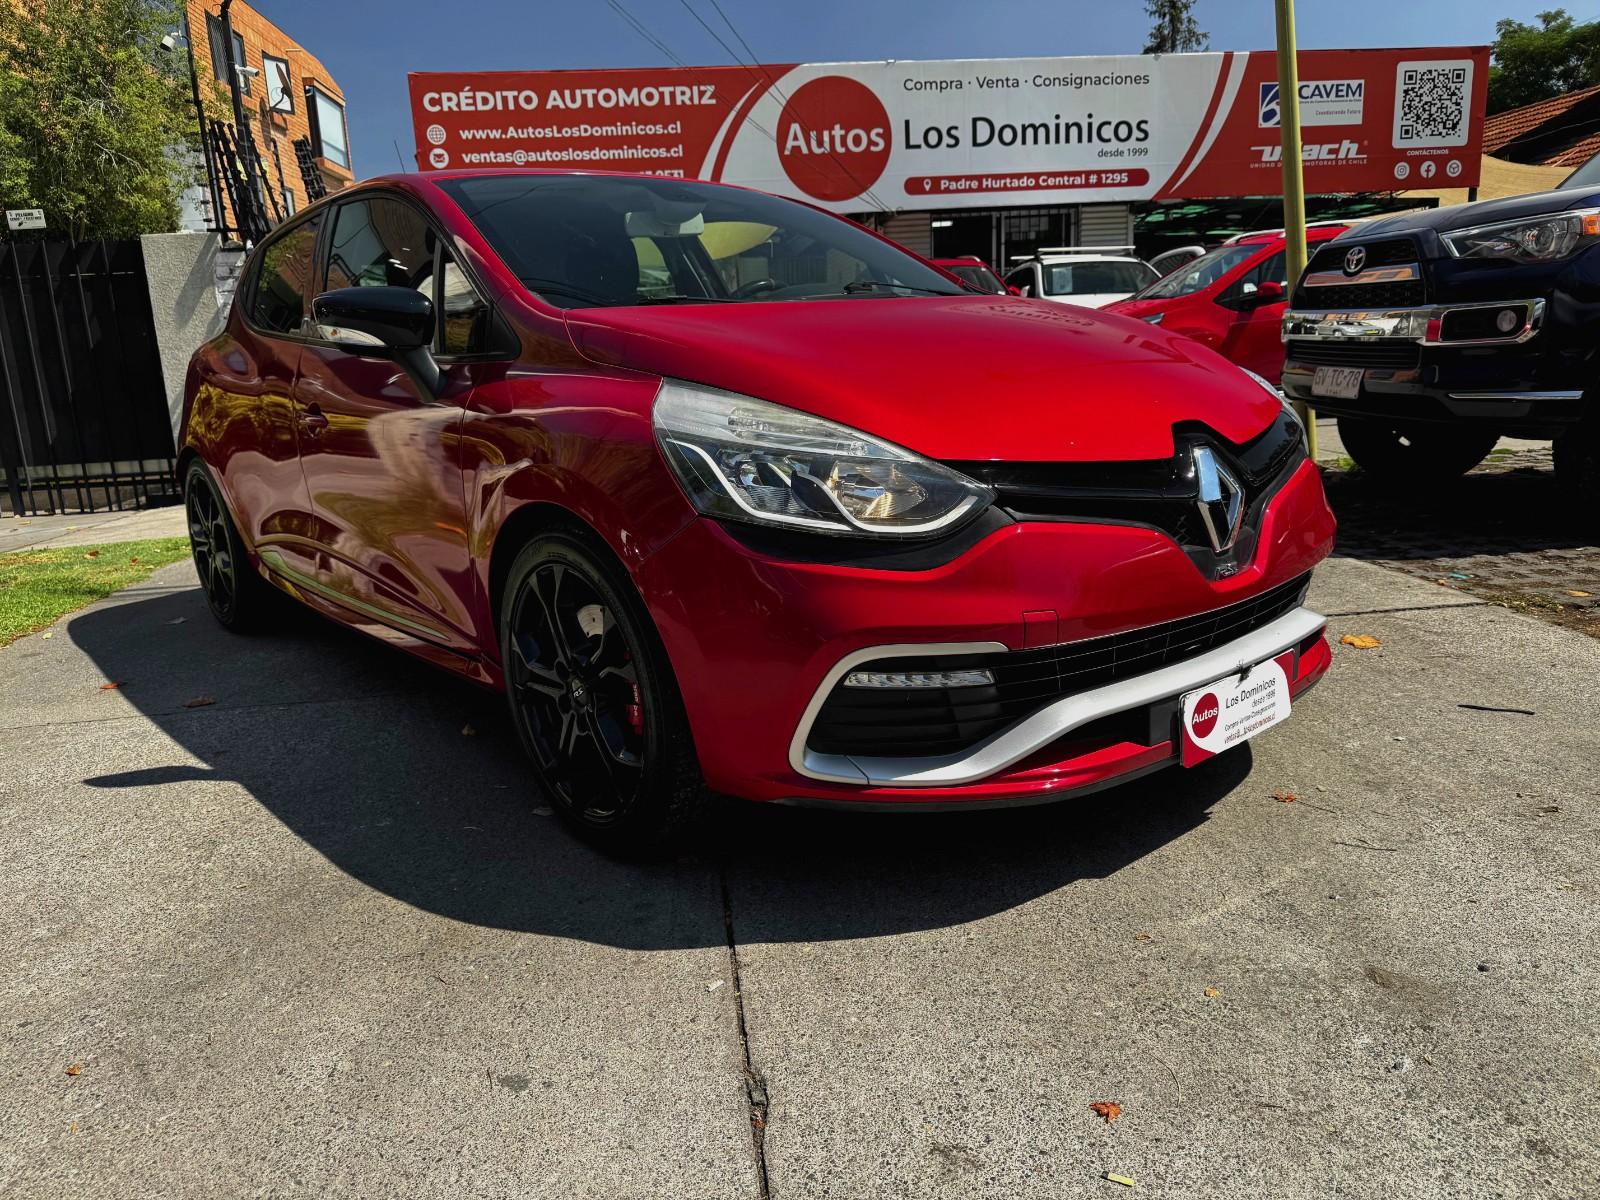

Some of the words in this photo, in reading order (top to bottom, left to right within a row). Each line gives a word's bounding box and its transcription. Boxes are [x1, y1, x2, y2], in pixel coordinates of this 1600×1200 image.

[903, 77, 963, 94] Compra
[975, 75, 1020, 90] Venta
[1032, 72, 1150, 90] Consignaciones
[1298, 83, 1363, 99] CAVEM
[423, 86, 539, 111] CRÉDITO
[546, 85, 716, 109] AUTOMOTRIZ
[459, 121, 681, 140] www.AutosLosDominicos.cl
[784, 122, 886, 155] Autos
[903, 117, 960, 150] Los
[971, 113, 1150, 148] Dominicos
[462, 145, 683, 163] ventas@autoslosdominicos.cl
[1097, 147, 1125, 159] desde
[1127, 146, 1149, 158] 1999
[940, 177, 979, 191] Padre
[982, 175, 1036, 189] Hurtado
[1039, 173, 1086, 187] Central
[1088, 173, 1098, 185] #
[1100, 172, 1129, 185] 1295
[1225, 697, 1239, 709] Los
[1240, 677, 1276, 702] Dominicos
[1192, 707, 1219, 725] Autos
